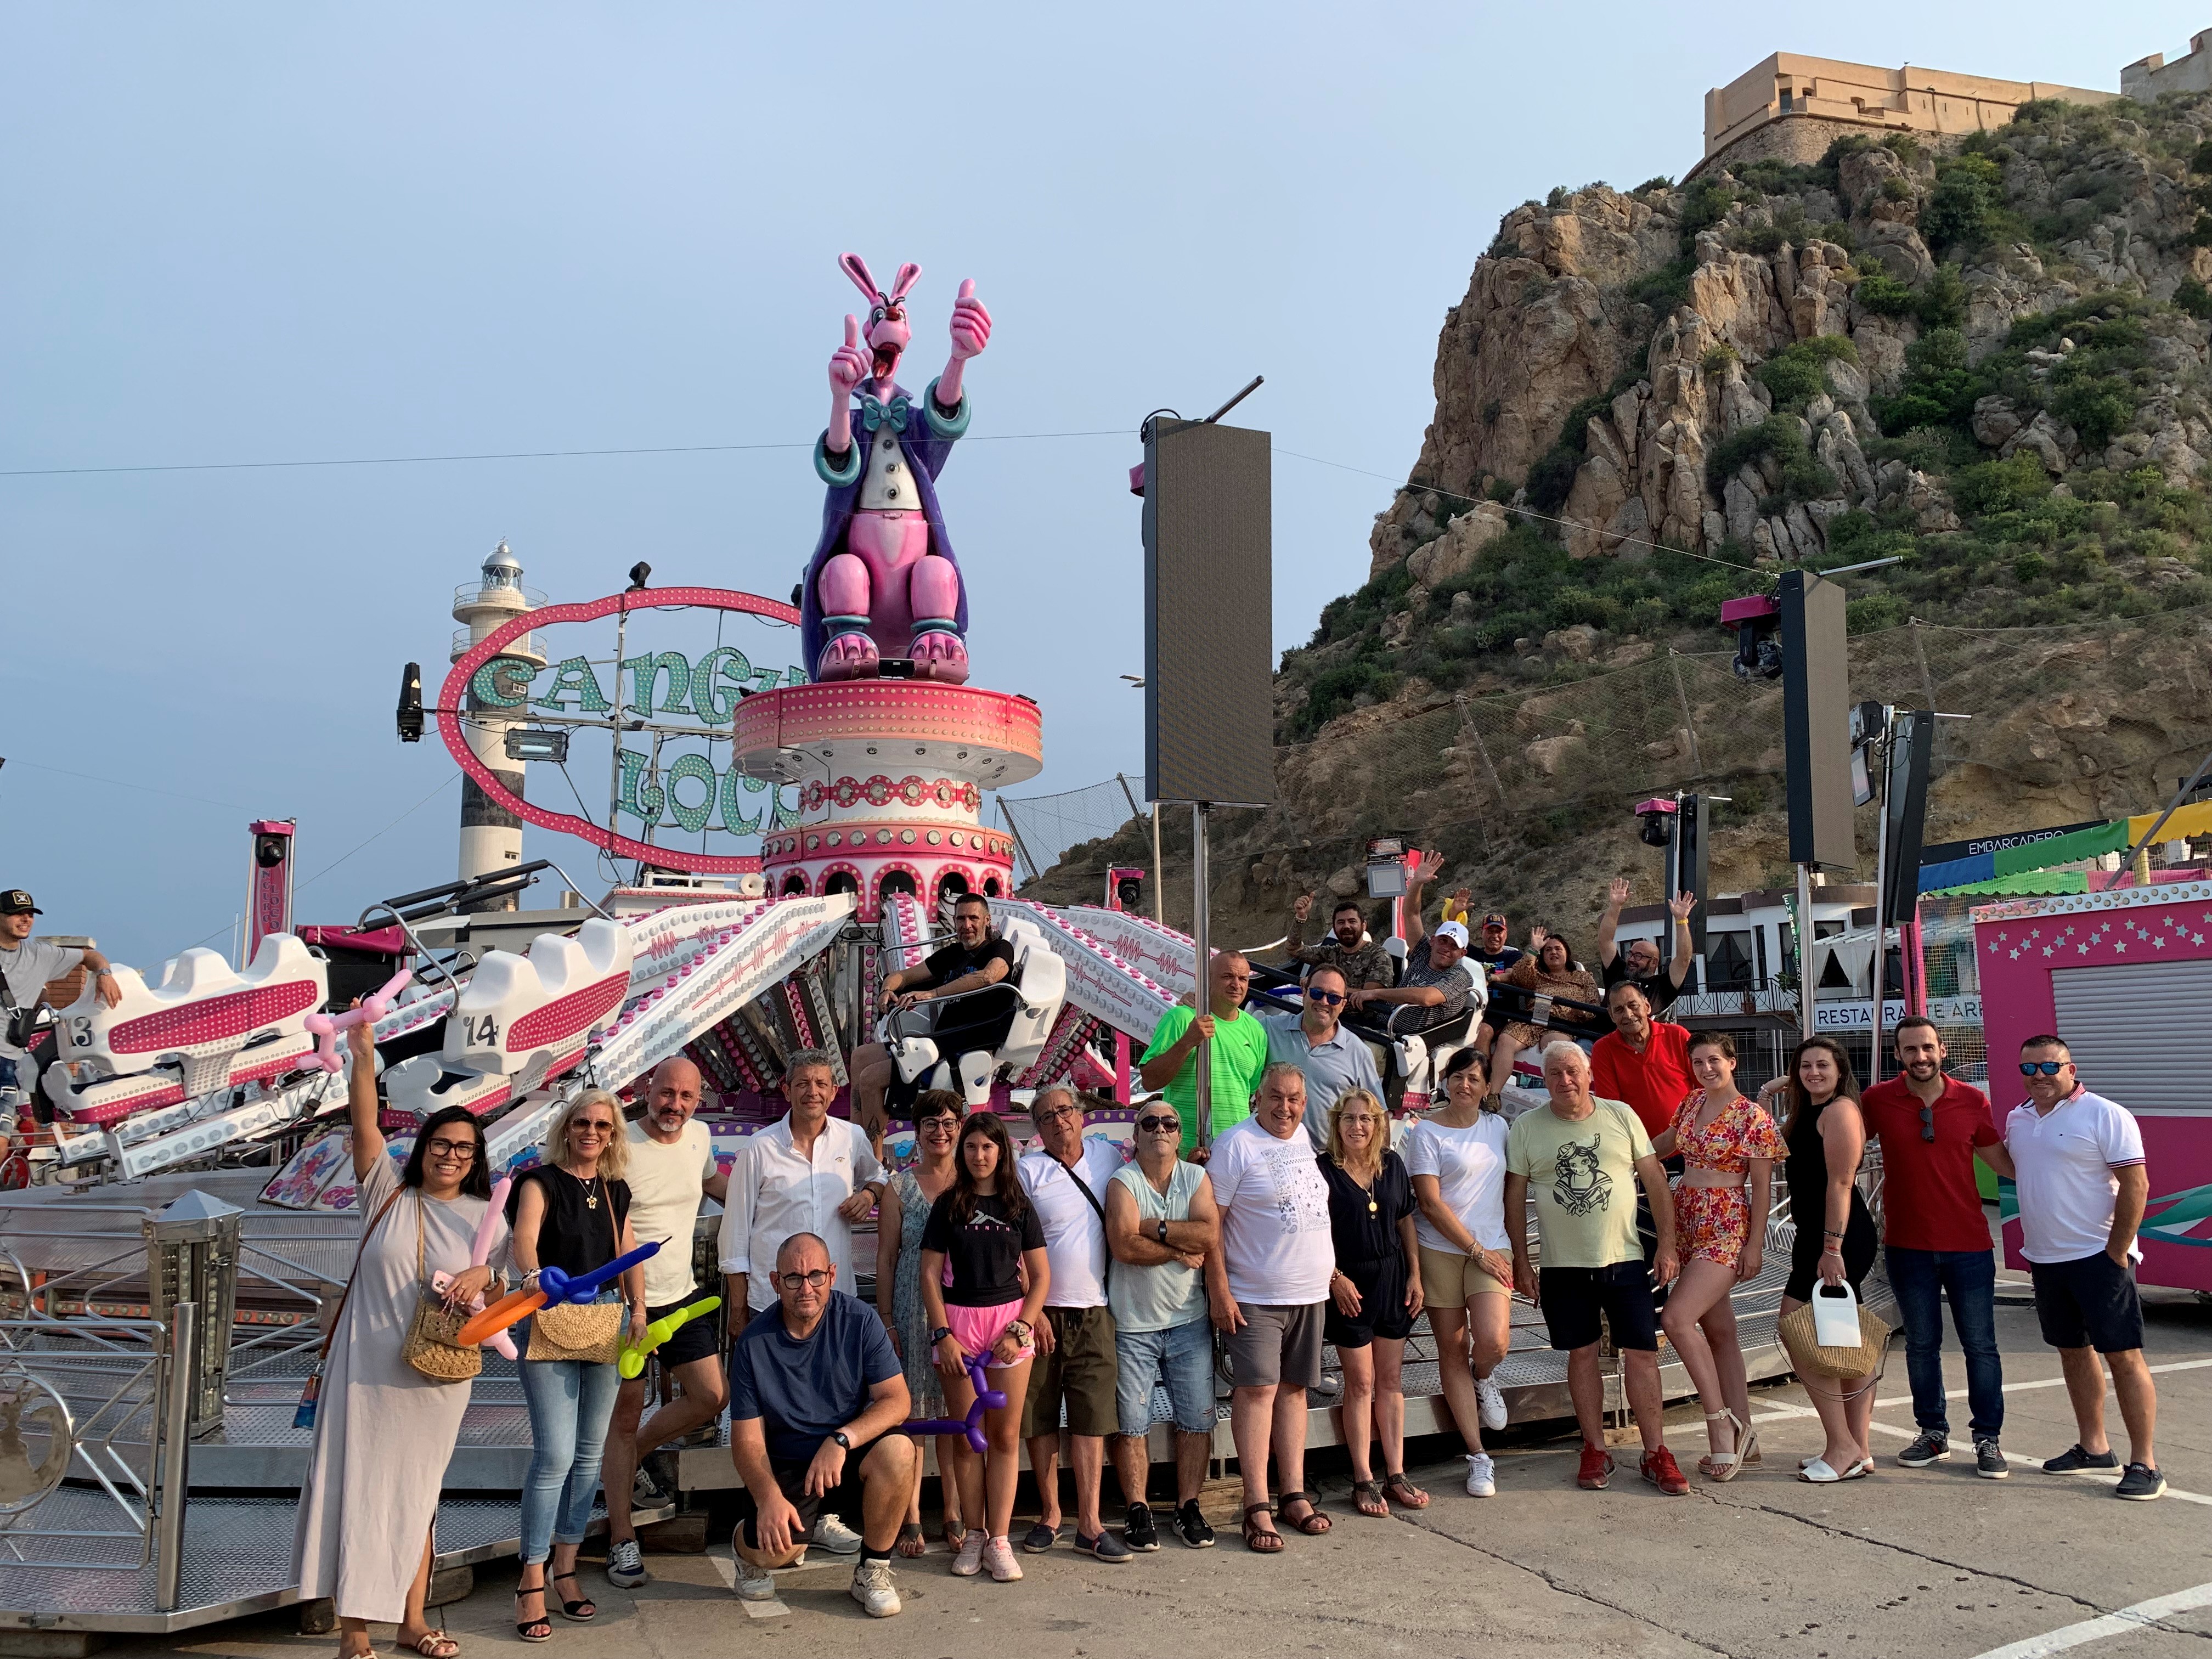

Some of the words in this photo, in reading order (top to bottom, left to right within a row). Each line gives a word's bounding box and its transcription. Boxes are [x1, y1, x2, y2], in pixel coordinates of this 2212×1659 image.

[270, 884, 280, 930] LOCO
[1784, 897, 1802, 982] EMBARCADERO
[462, 1014, 499, 1047] 14
[1025, 1006, 1051, 1041] 1
[1818, 1003, 1945, 1025] RESTARATE
